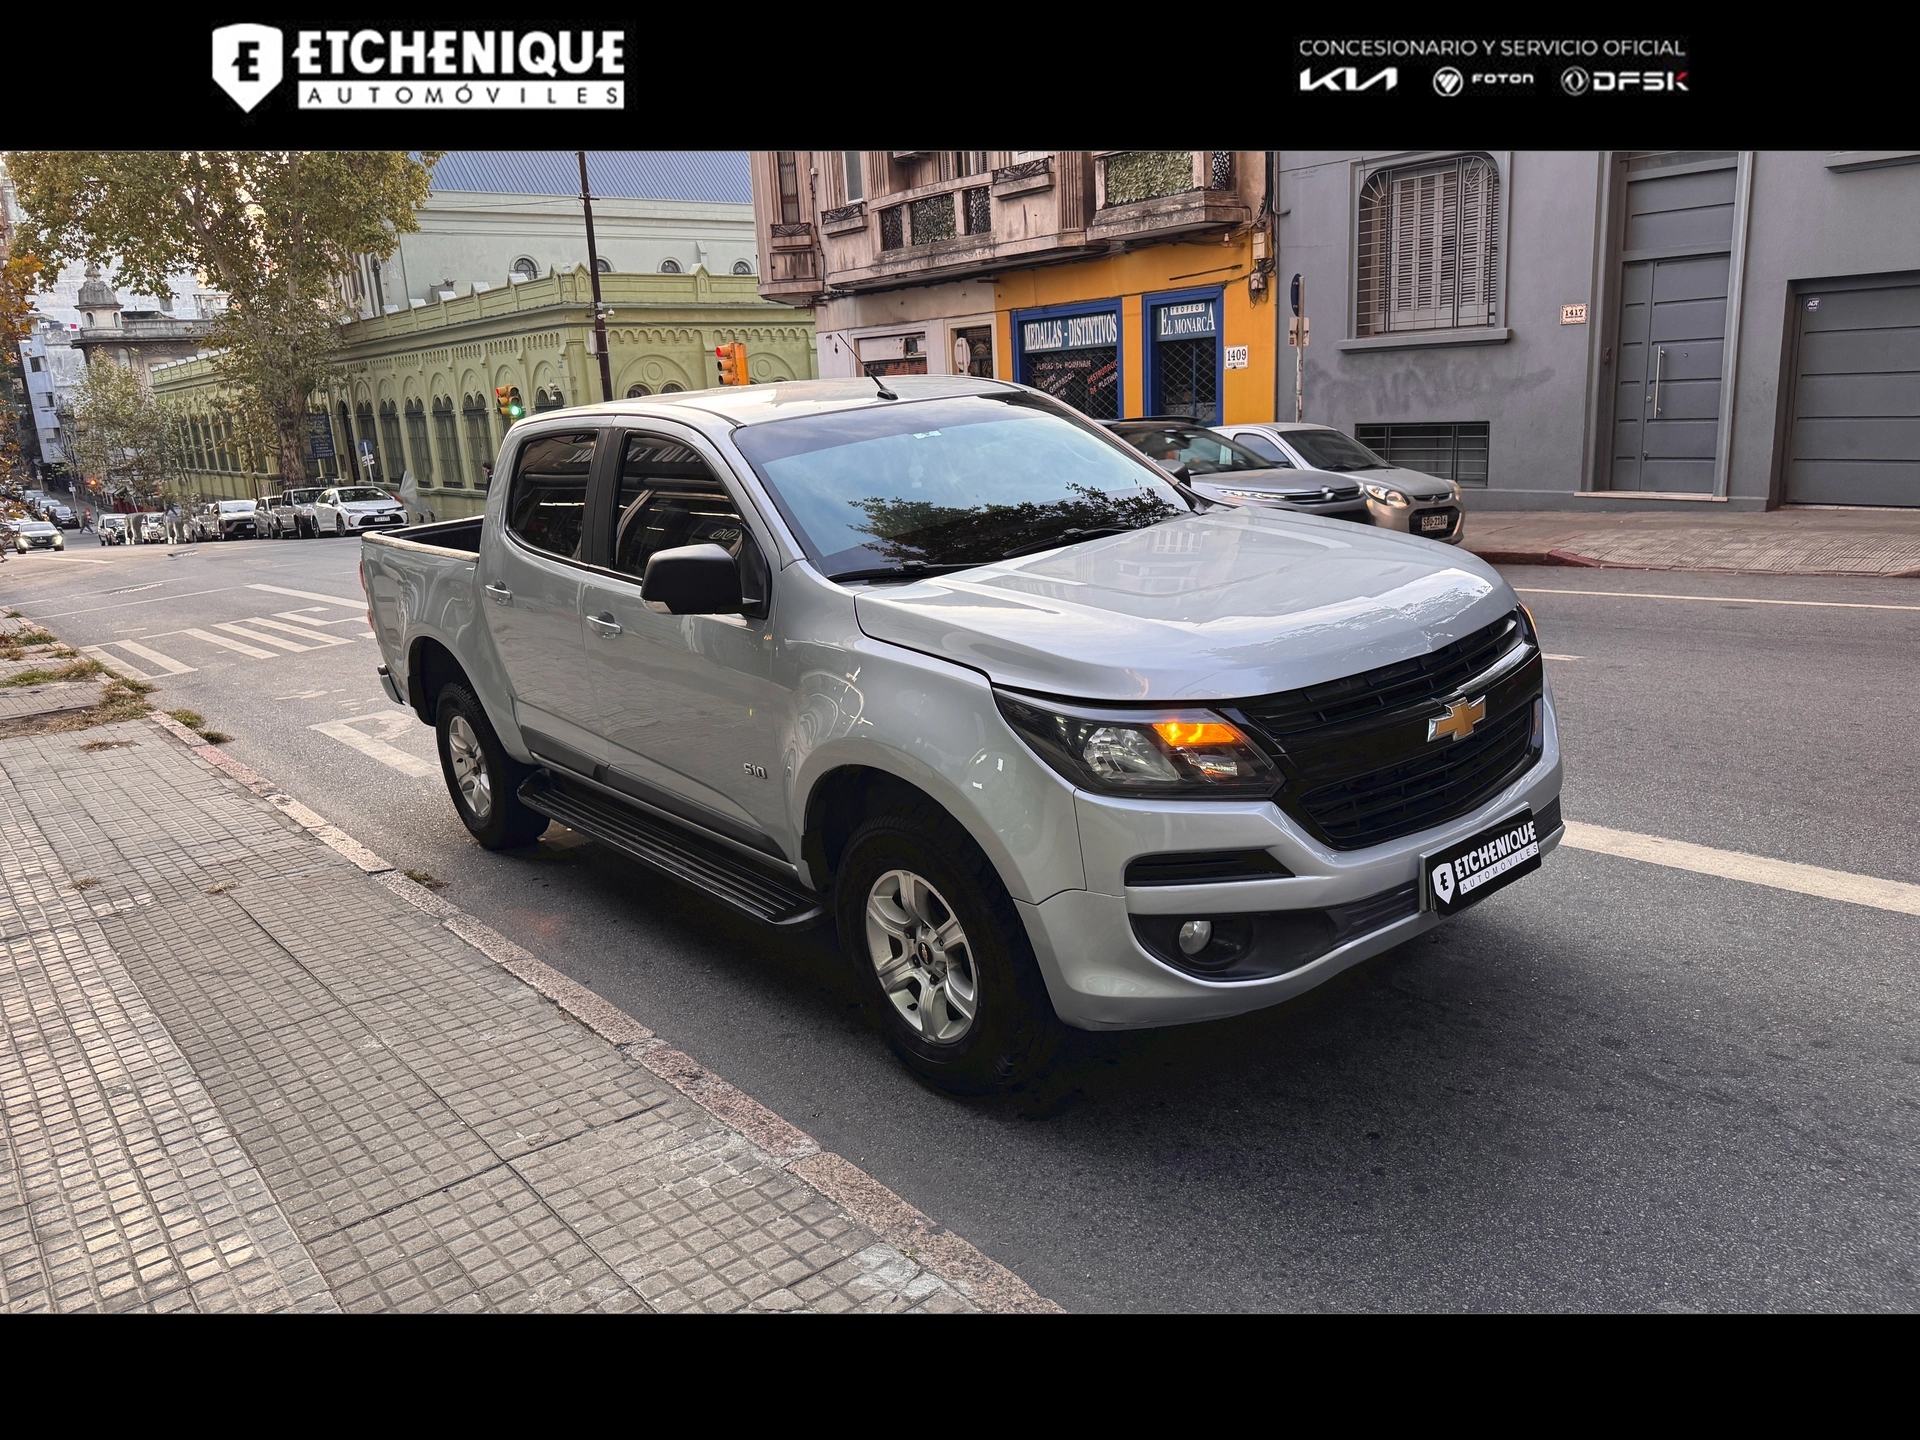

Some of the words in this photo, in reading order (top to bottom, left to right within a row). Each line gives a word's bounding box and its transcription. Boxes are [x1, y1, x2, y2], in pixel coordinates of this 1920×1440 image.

[1171, 304, 1204, 314] TROFEOS
[1024, 318, 1063, 350] MEDALLAS
[1068, 313, 1117, 347] DISTINTIVOS
[1227, 349, 1246, 361] 1409
[743, 762, 767, 779] S10
[1454, 821, 1536, 879] ETCHENIQUE
[1462, 845, 1538, 892] AUTOMÓVILES
